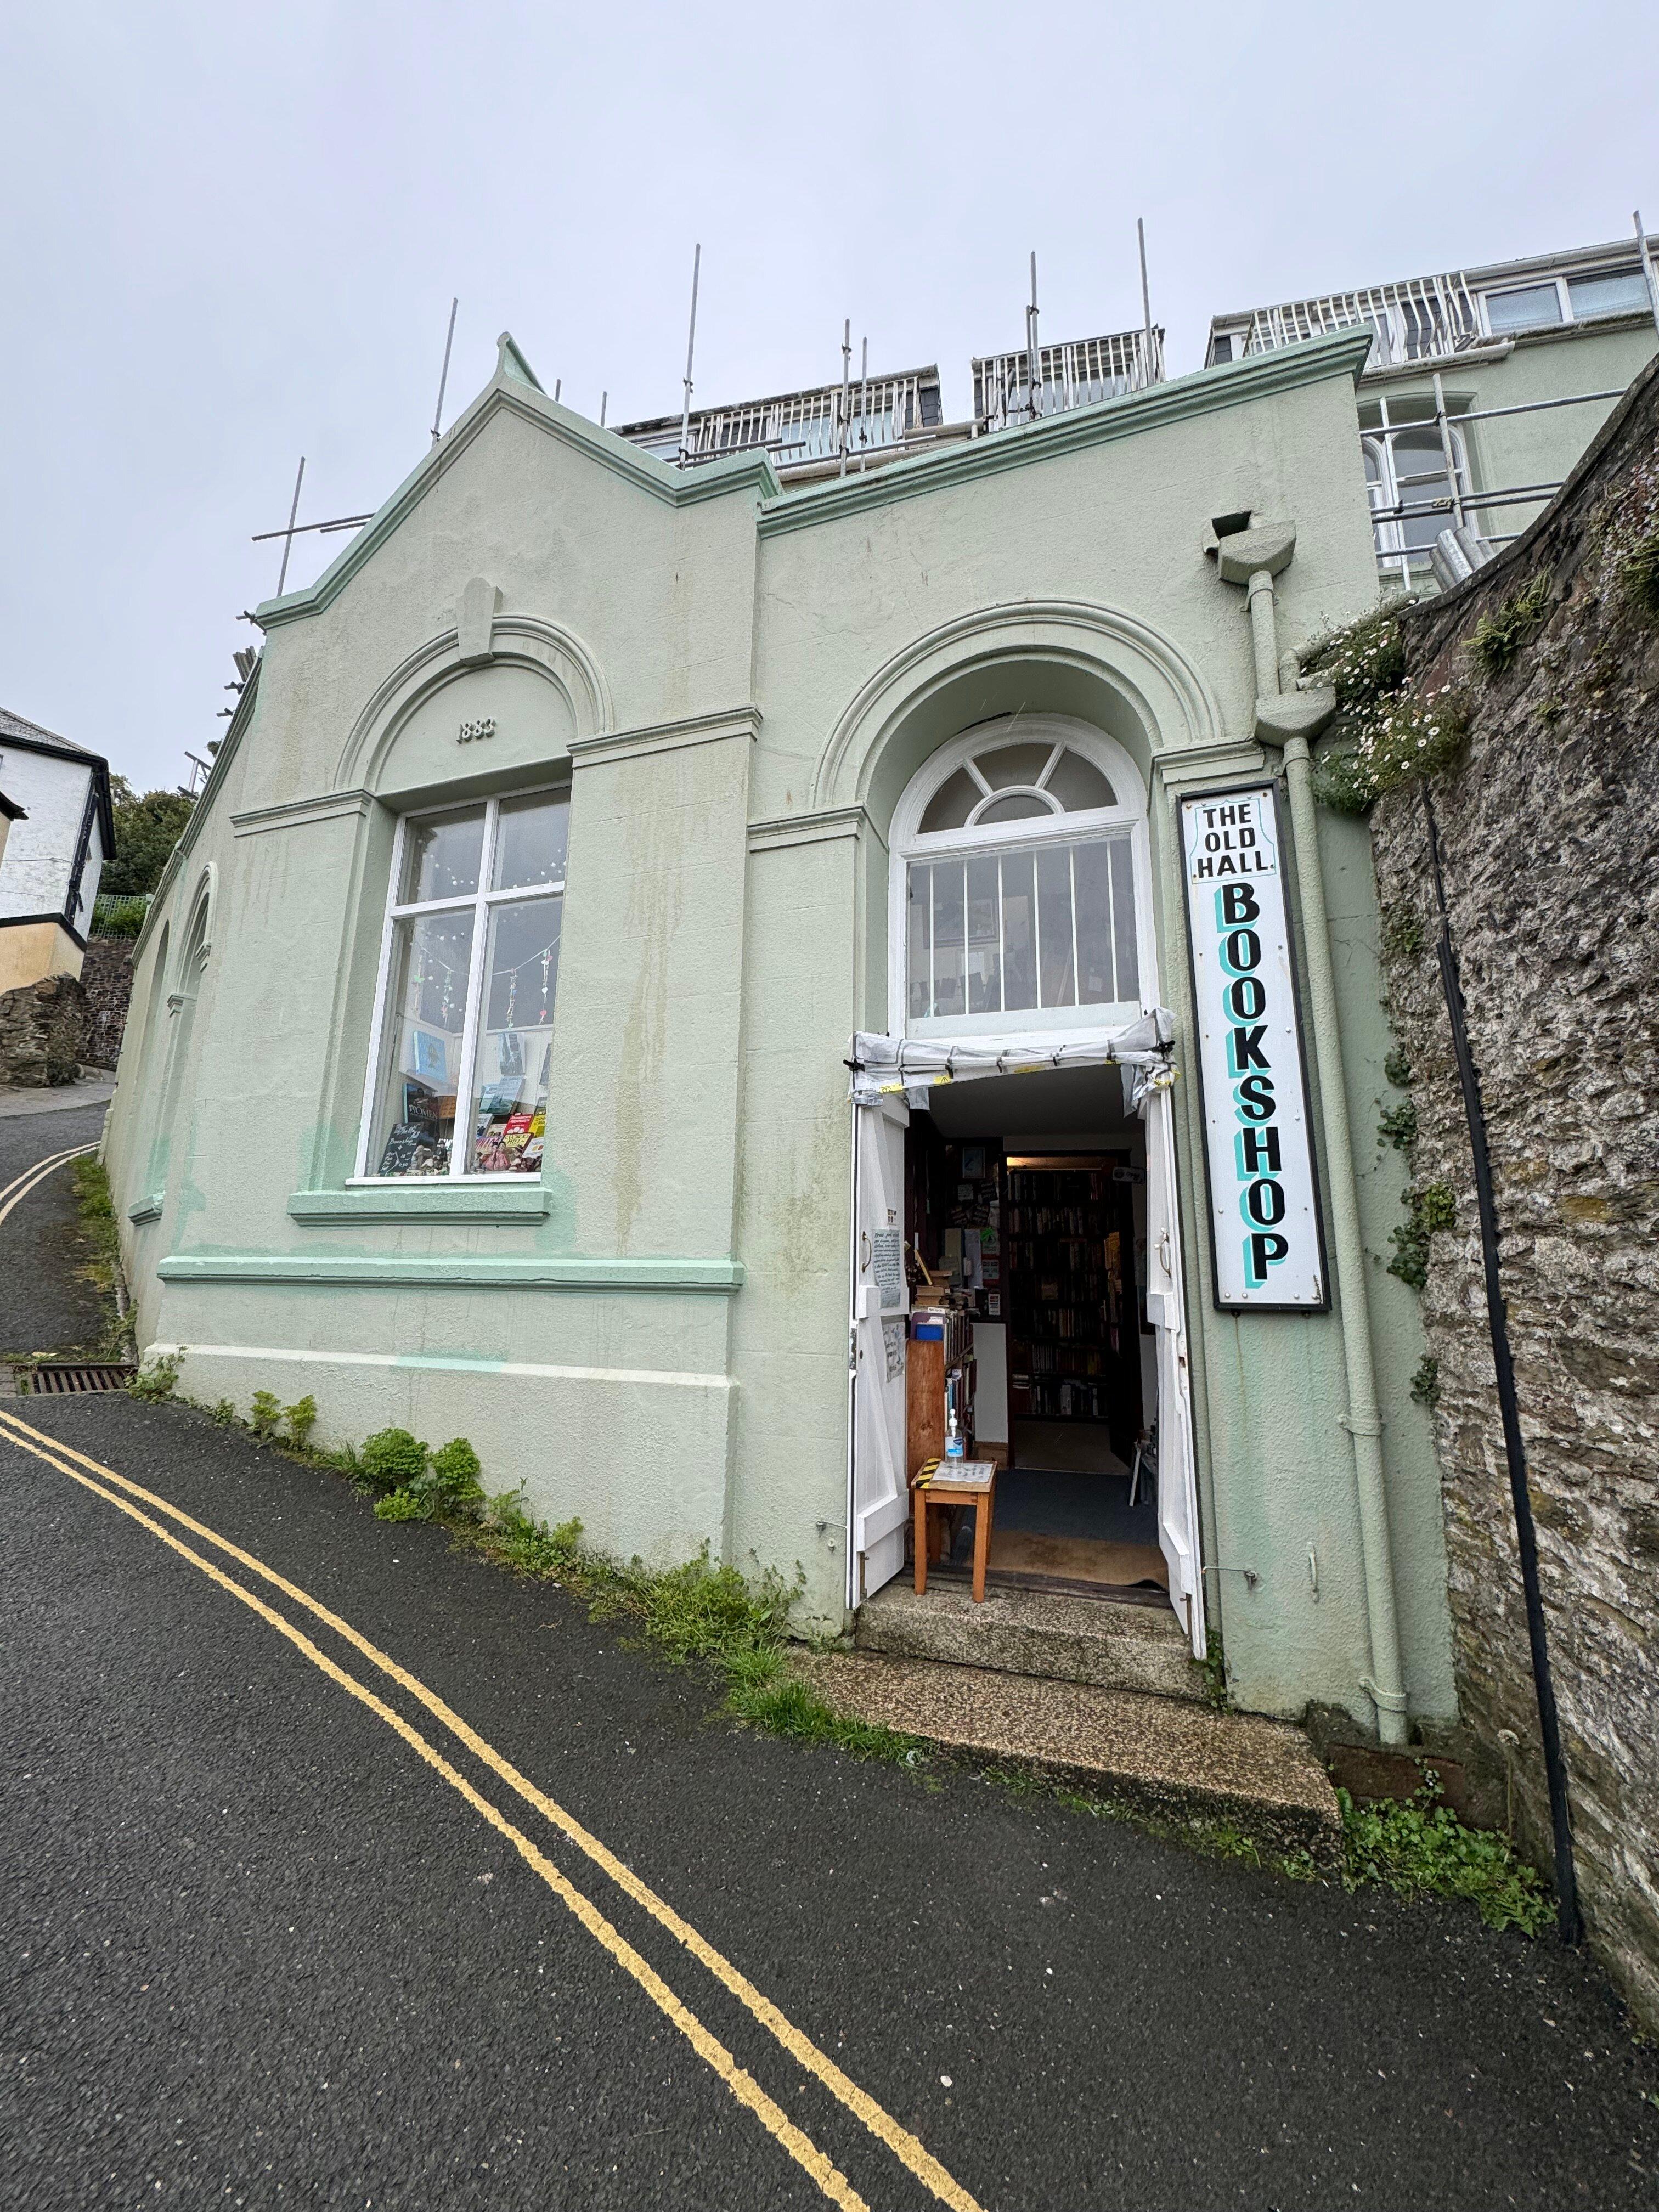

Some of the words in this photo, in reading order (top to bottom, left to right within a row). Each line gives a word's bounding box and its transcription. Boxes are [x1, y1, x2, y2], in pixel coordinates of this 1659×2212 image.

[456, 716, 496, 744] 1883
[1203, 803, 1252, 829] THE
[1205, 827, 1256, 853] OLD
[1197, 850, 1268, 879] HALL
[1221, 882, 1289, 1282] BOOKSHOP
